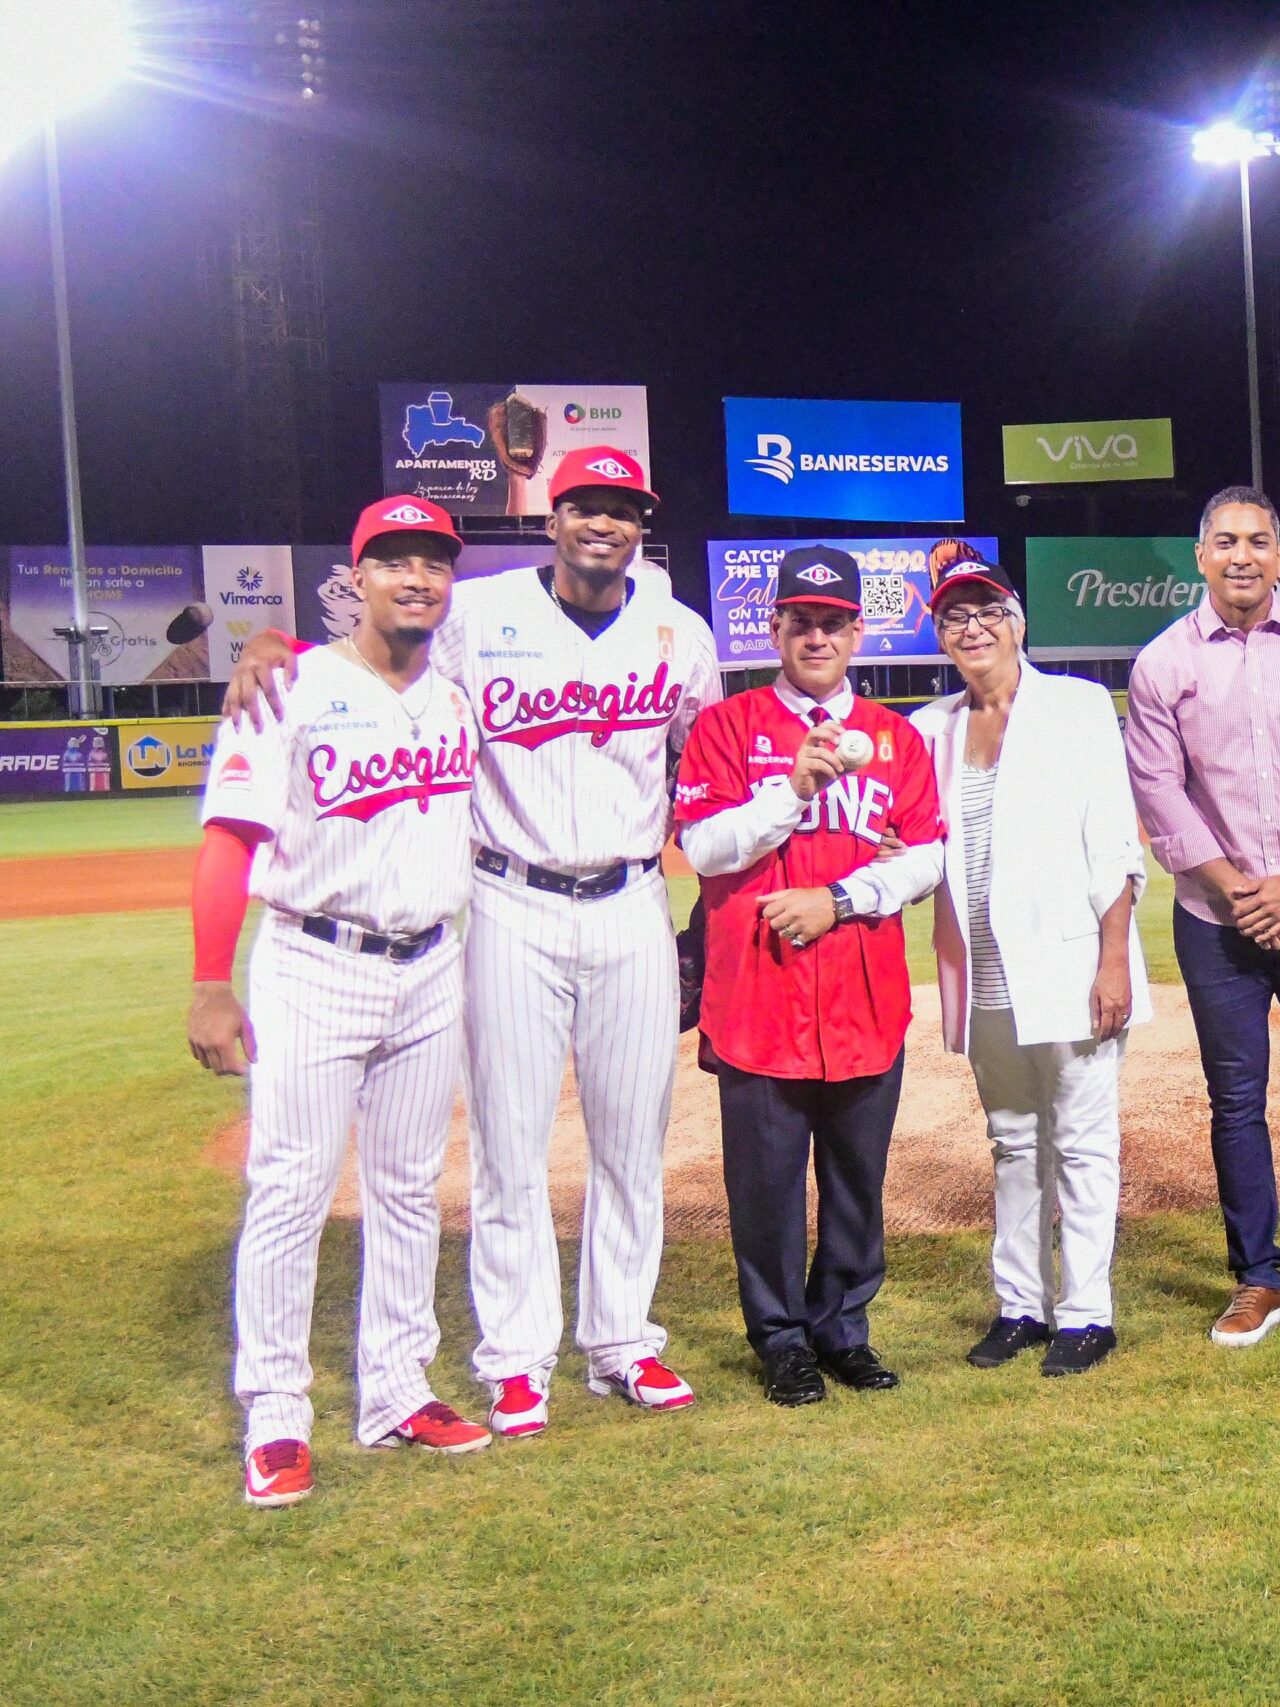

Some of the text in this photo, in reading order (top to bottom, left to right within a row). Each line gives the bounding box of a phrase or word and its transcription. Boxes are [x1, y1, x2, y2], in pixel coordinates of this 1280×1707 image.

[589, 407, 622, 420] BHD
[552, 448, 640, 457] ATR RES
[395, 459, 497, 470] APARTAMENTOS
[800, 454, 949, 473] BANRESERVAS
[469, 468, 498, 481] RD
[724, 549, 785, 563] CATCH
[17, 564, 39, 575] Tus
[107, 567, 117, 575] a
[121, 565, 182, 576] Domicilio
[724, 565, 778, 578] THE B
[135, 579, 145, 588] a
[716, 568, 778, 609] Sal
[1067, 569, 1207, 607] Presiden
[220, 592, 283, 605] Vimenca
[728, 608, 776, 620] ON TH
[729, 622, 771, 635] MAR
[110, 635, 158, 646] Gratis
[729, 639, 775, 654] @ADV
[478, 650, 544, 659] BANRESERVAS
[483, 661, 683, 748] Escogido
[176, 744, 197, 758] La
[0, 755, 61, 771] RADE
